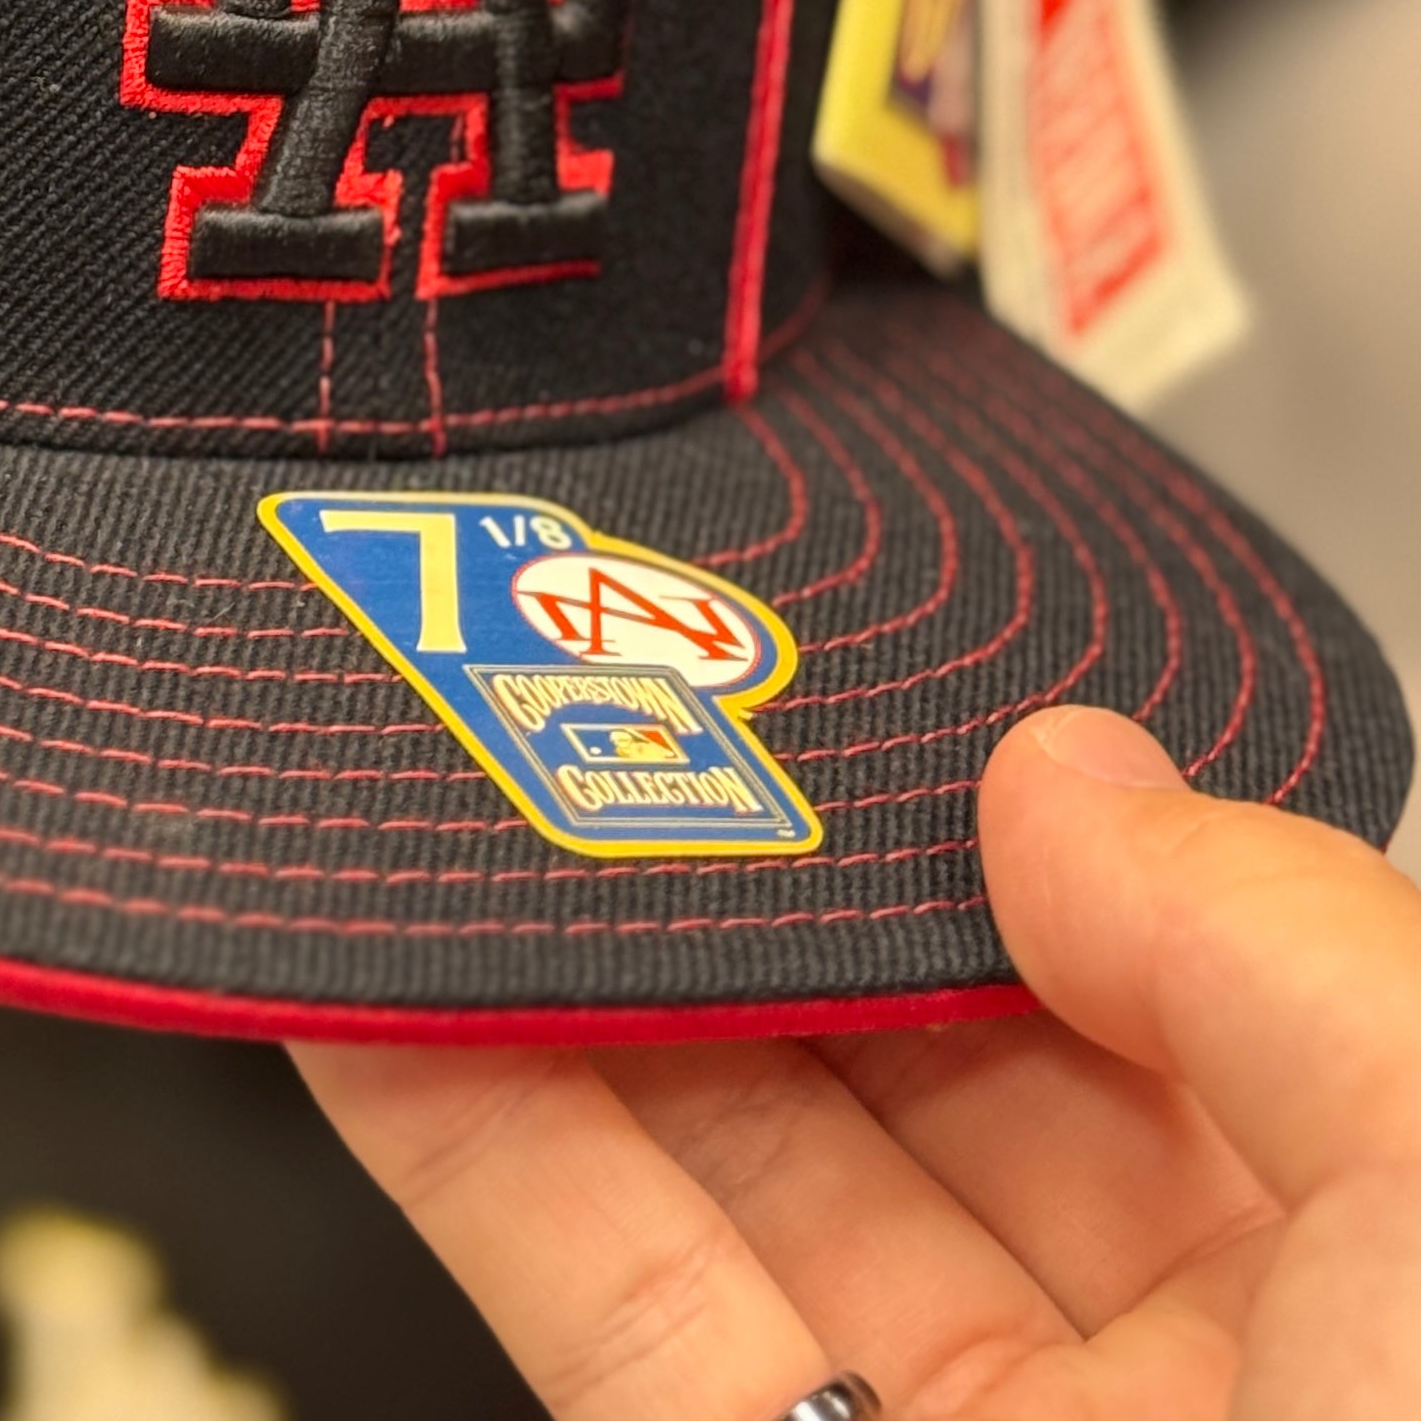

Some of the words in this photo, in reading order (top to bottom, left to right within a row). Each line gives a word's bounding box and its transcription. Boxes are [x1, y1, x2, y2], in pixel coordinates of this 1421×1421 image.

[319, 510, 467, 654] 7
[480, 514, 573, 550] 1/8
[492, 674, 704, 734] COOPERSTOWN
[556, 765, 764, 814] COLLECTION
